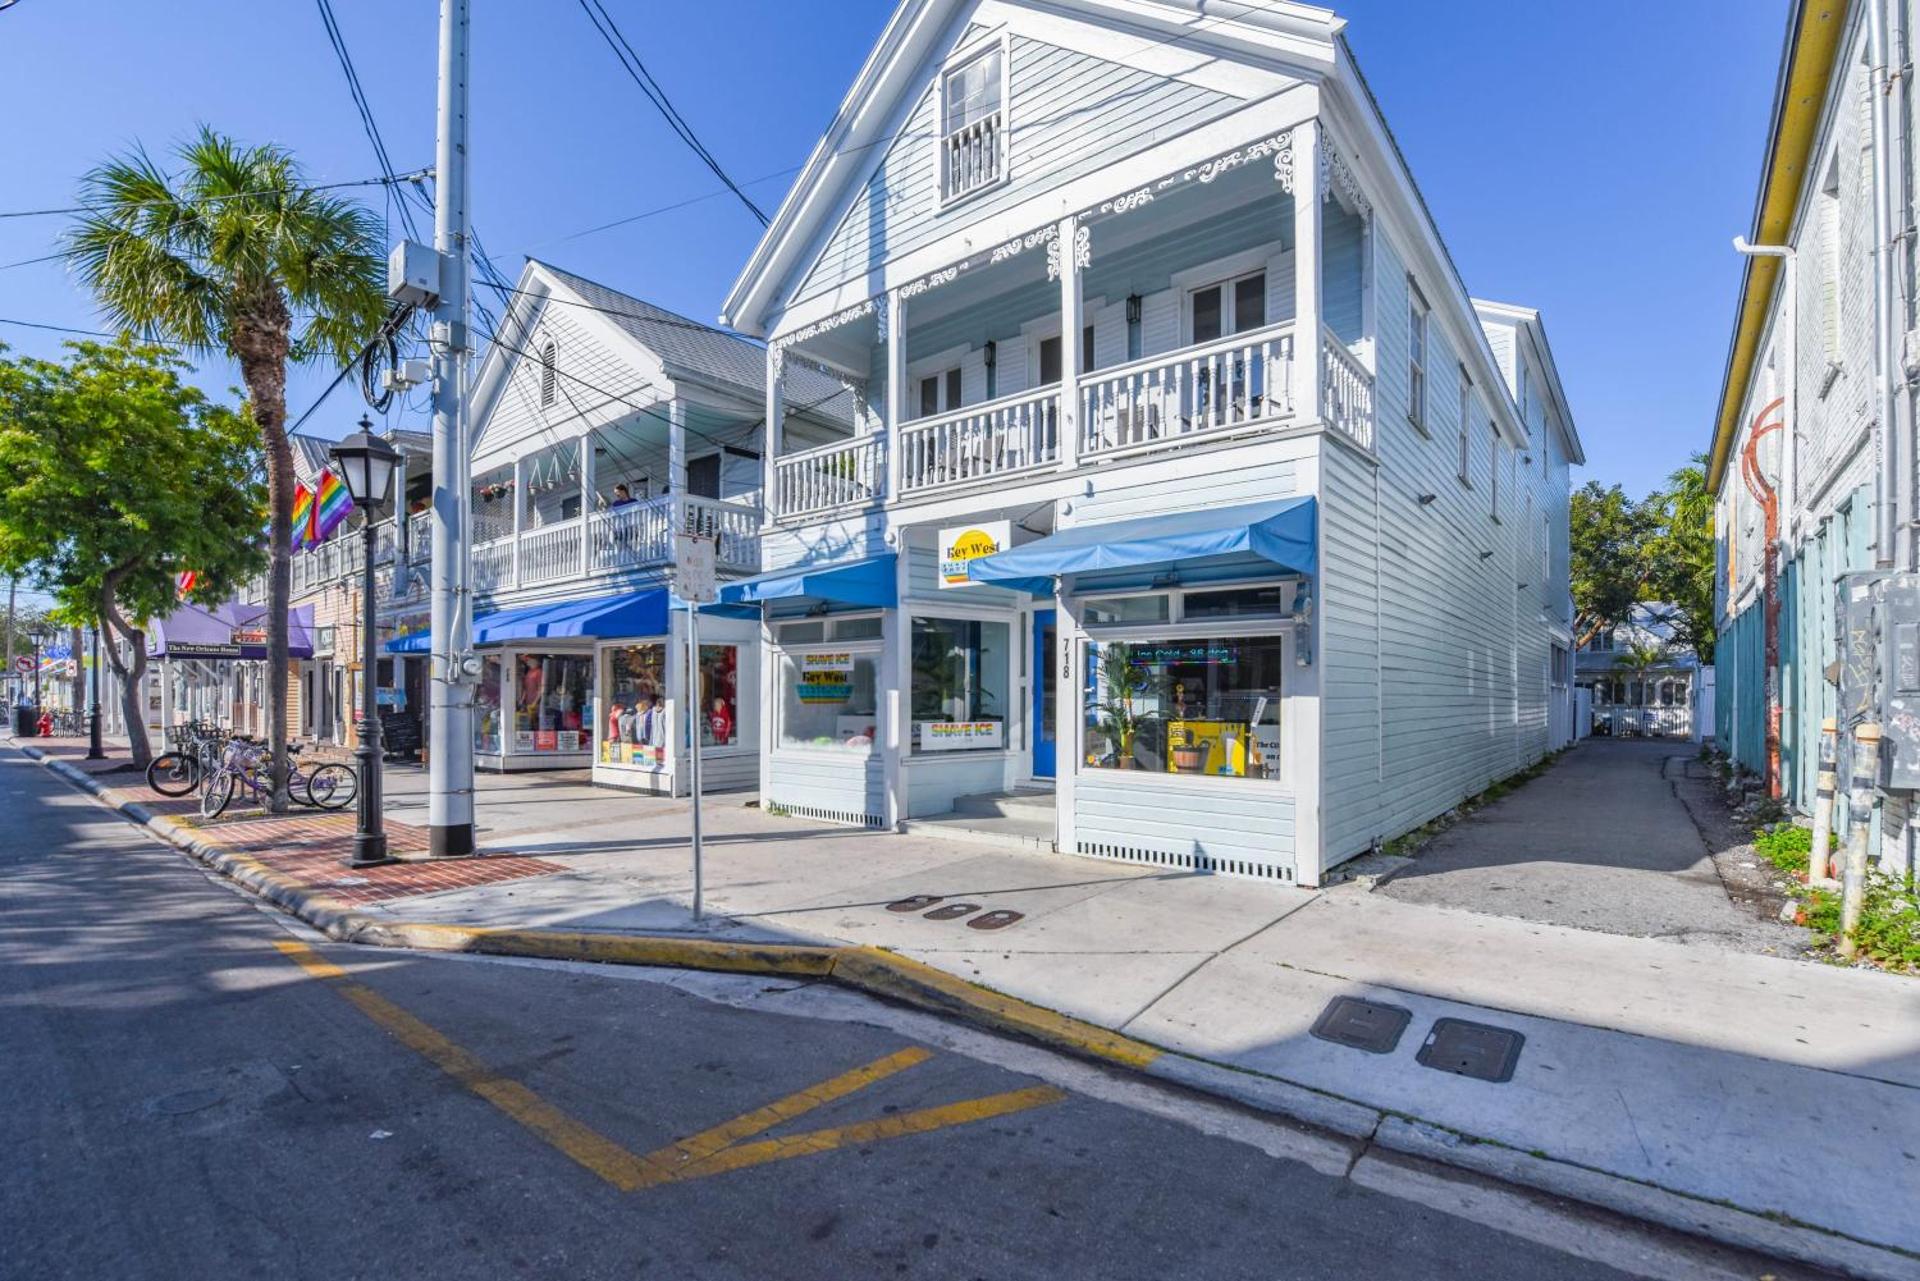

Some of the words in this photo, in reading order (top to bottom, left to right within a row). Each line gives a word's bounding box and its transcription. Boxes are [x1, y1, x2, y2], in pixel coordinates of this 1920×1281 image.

[947, 546, 968, 560] Key
[970, 541, 1000, 555] West
[806, 654, 834, 665] SHAVE
[835, 653, 850, 664] ICE
[802, 671, 821, 685] Key
[823, 671, 848, 683] West
[931, 723, 972, 737] SHAVE
[974, 723, 993, 737] ICE
